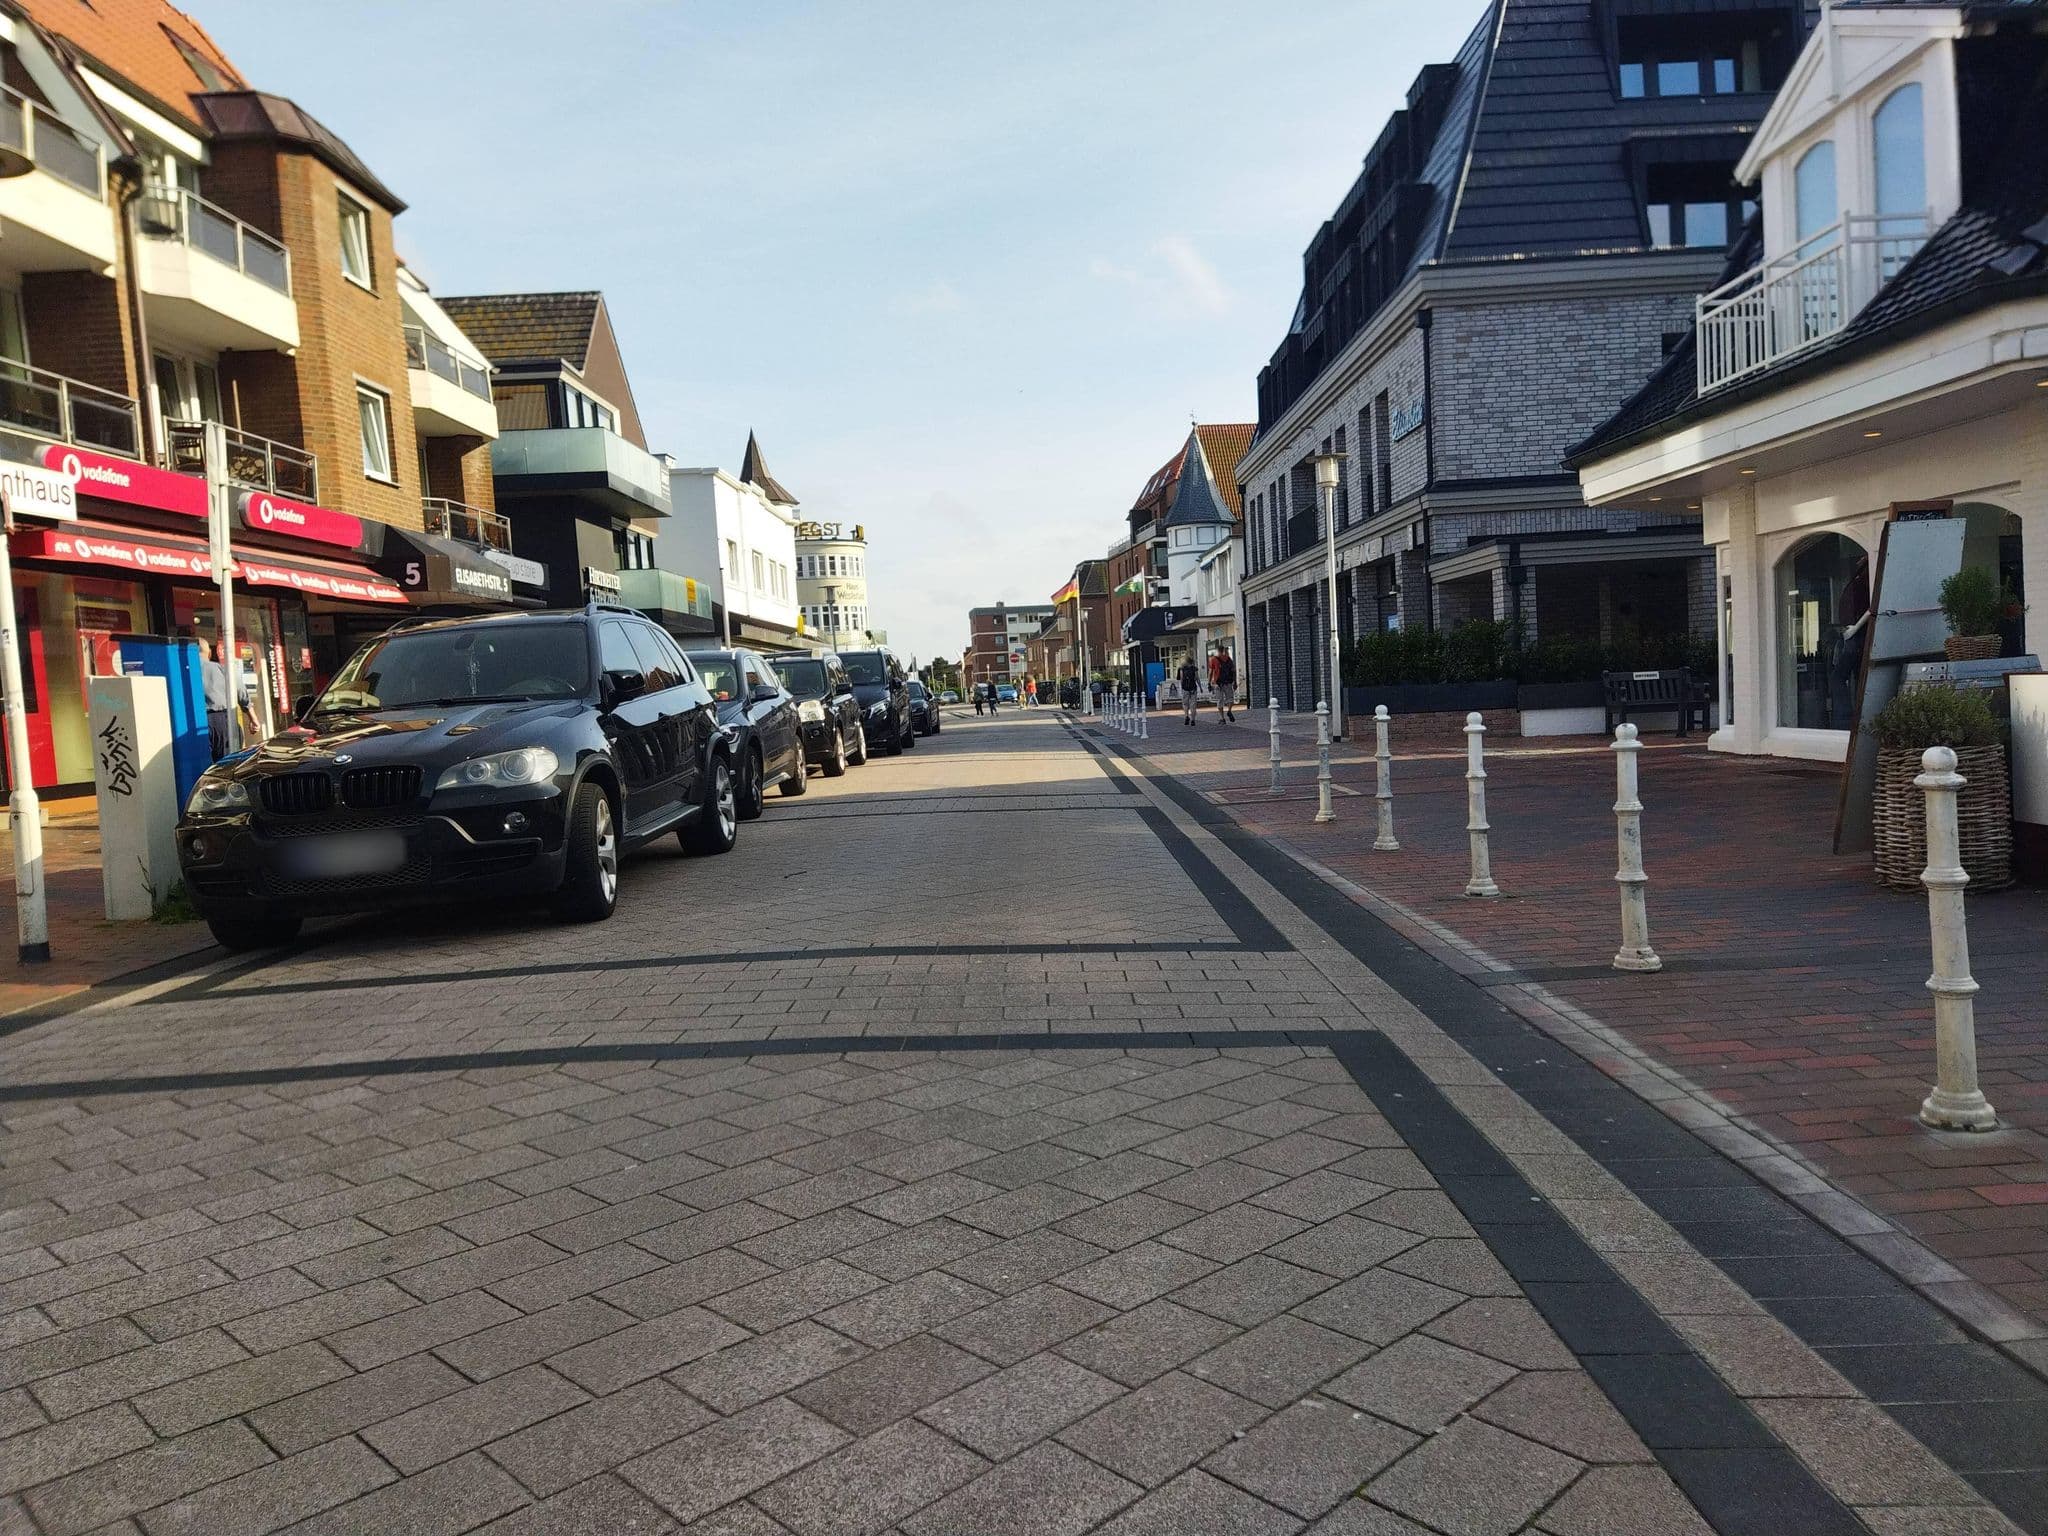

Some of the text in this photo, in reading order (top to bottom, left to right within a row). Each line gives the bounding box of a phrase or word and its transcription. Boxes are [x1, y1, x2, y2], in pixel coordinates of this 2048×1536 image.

[83, 466, 130, 487] vodafone
[273, 508, 305, 525] vodafone
[405, 562, 421, 586] 5
[503, 577, 509, 592] 5
[268, 650, 280, 699] BERATUNG
